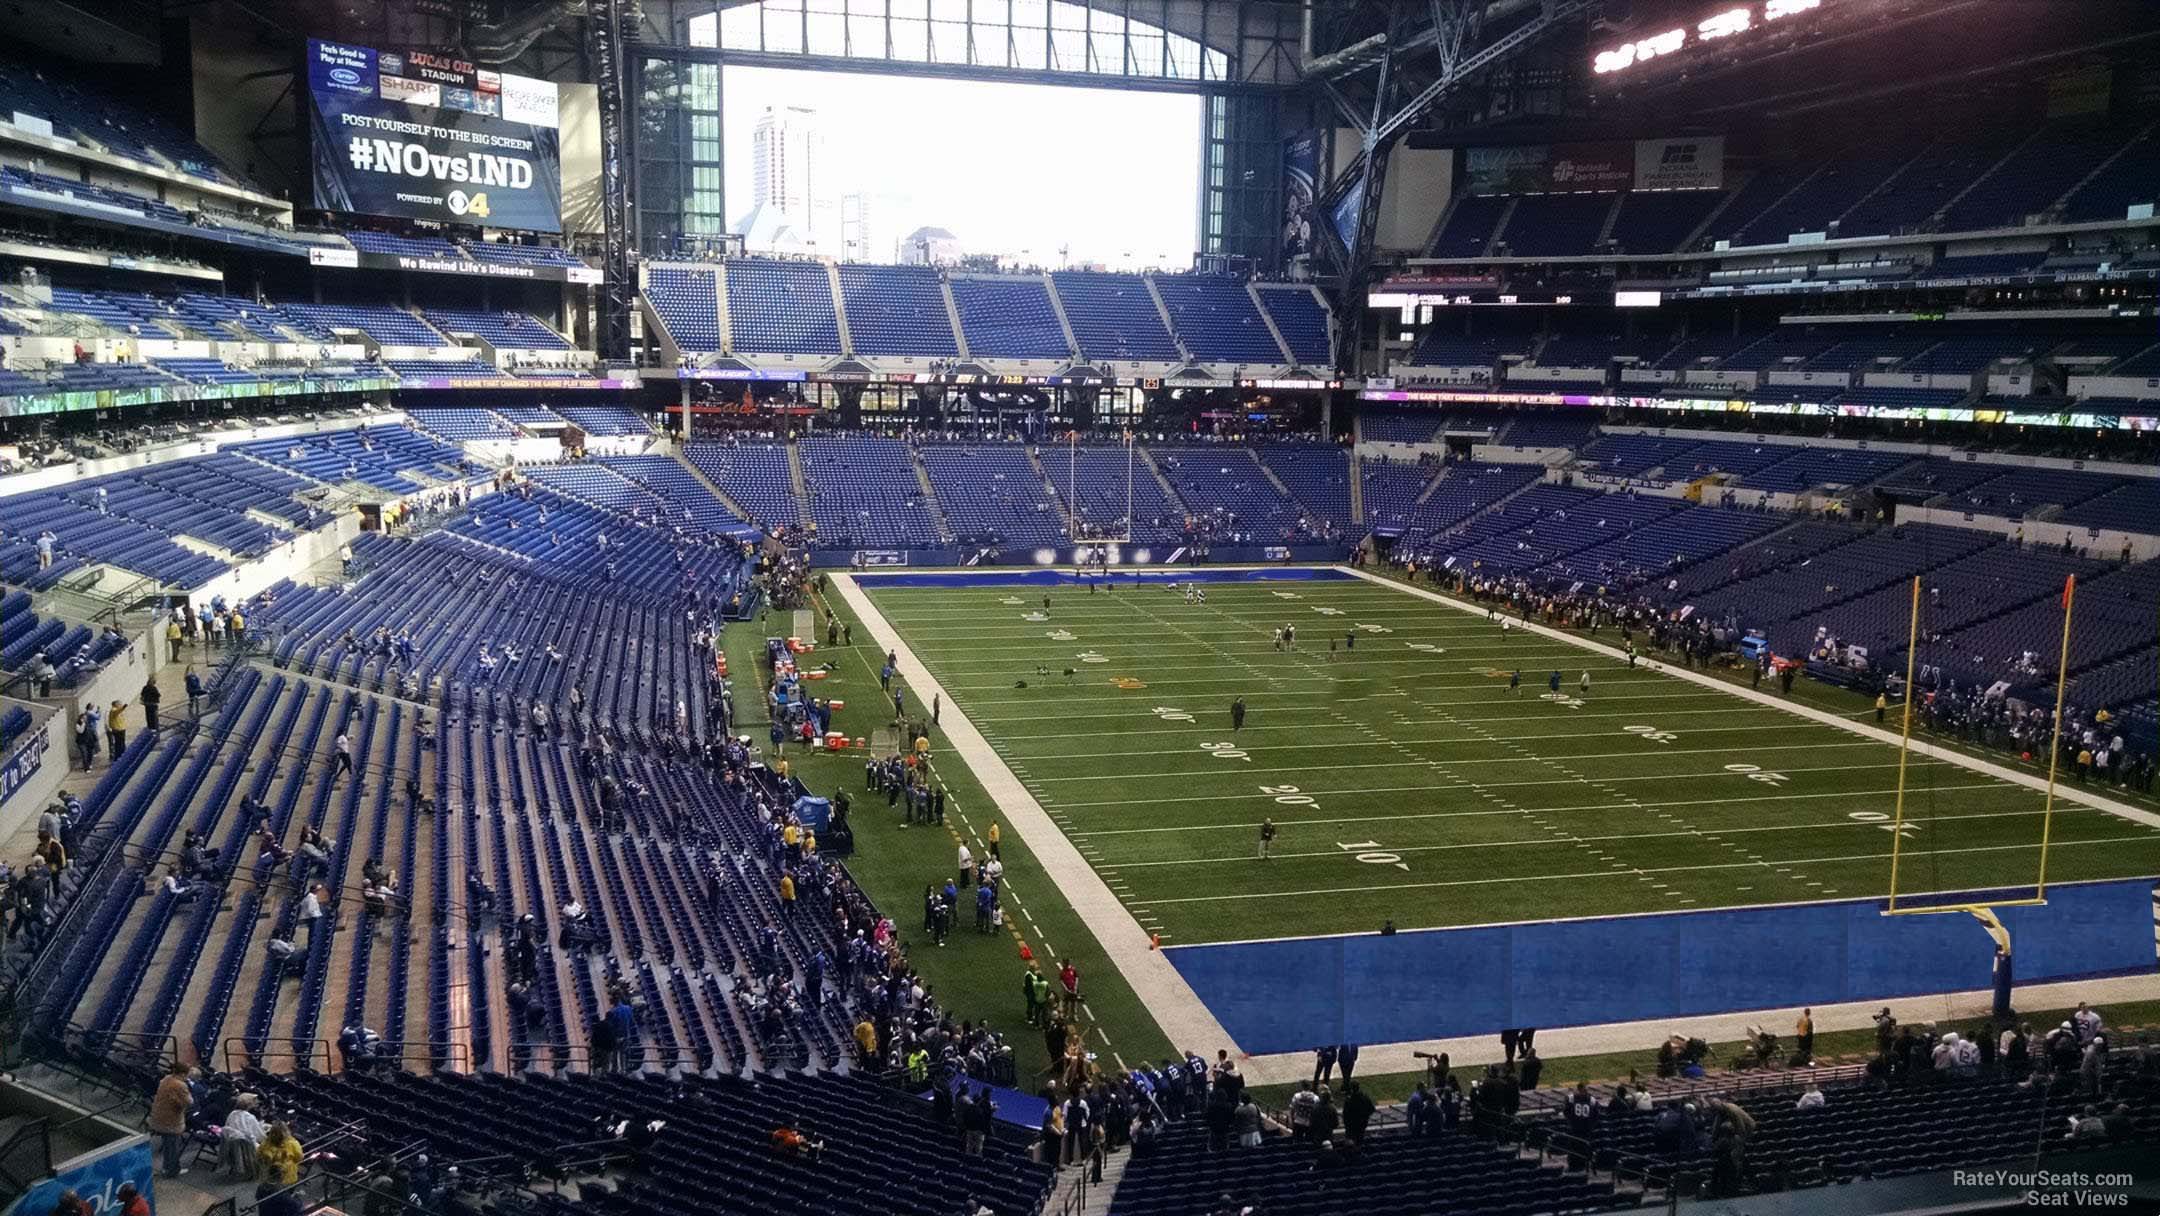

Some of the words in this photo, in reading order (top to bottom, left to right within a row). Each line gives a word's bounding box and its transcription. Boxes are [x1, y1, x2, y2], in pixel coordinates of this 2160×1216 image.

[320, 53, 336, 65] Play
[336, 57, 344, 65] at
[339, 47, 357, 58] Good
[409, 51, 450, 71] LUCAS
[452, 60, 475, 75] OIL
[421, 68, 465, 84] STADIUM
[381, 77, 439, 95] SHARP
[342, 113, 373, 128] POST
[373, 118, 432, 136] YOURSELF
[432, 126, 448, 139] TO
[448, 129, 471, 142] THE
[471, 132, 490, 145] BIG
[490, 135, 533, 152] SCREEN!
[349, 136, 533, 190] #NOvsIND
[396, 192, 432, 205] POWERED
[432, 197, 444, 206] BY
[468, 192, 490, 218] 4
[400, 257, 417, 269] We
[419, 259, 457, 273] Rewind
[459, 262, 487, 274] Life's
[489, 265, 534, 278] Disasters
[1455, 296, 1471, 304] ATL
[1499, 295, 1517, 304] TEN
[1200, 741, 1248, 759] 30
[1259, 784, 1316, 806] 20
[1337, 840, 1402, 865] 10
[1168, 1067, 1180, 1080] 12
[1192, 1062, 1203, 1074] 13
